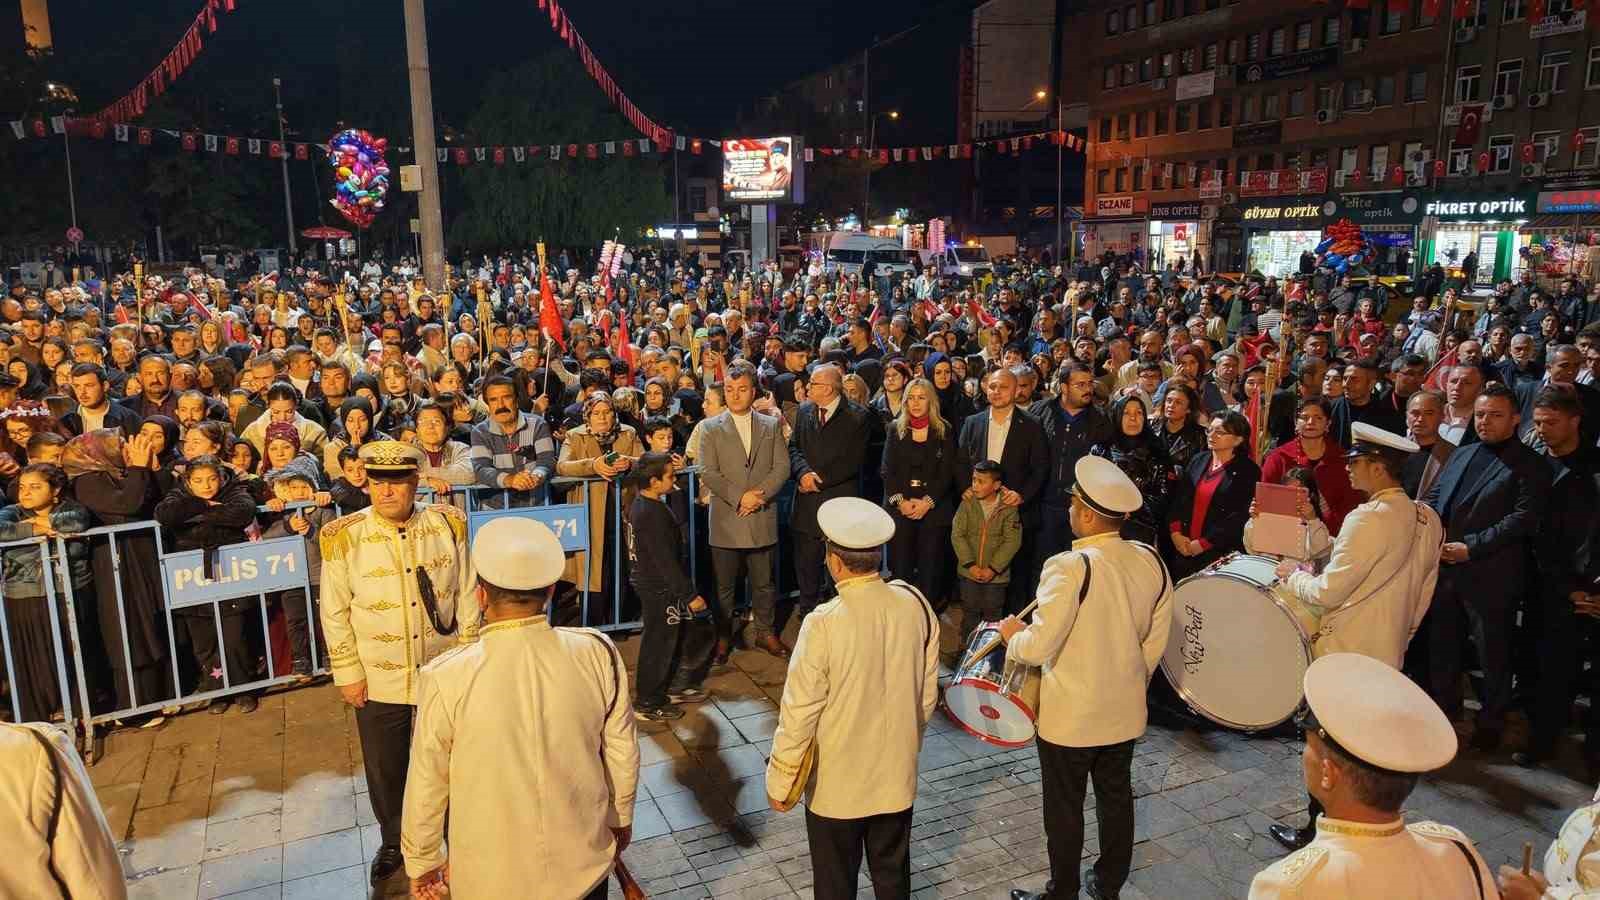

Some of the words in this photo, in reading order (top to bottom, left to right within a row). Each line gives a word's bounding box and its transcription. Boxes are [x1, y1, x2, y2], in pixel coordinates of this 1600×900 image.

[1098, 199, 1131, 210] ECZANE
[1244, 206, 1280, 220] GÜVEN
[1284, 203, 1320, 218] OPTİK
[1426, 199, 1476, 216] FİKRET
[1480, 197, 1525, 213] OPTİK
[265, 552, 295, 576] 71
